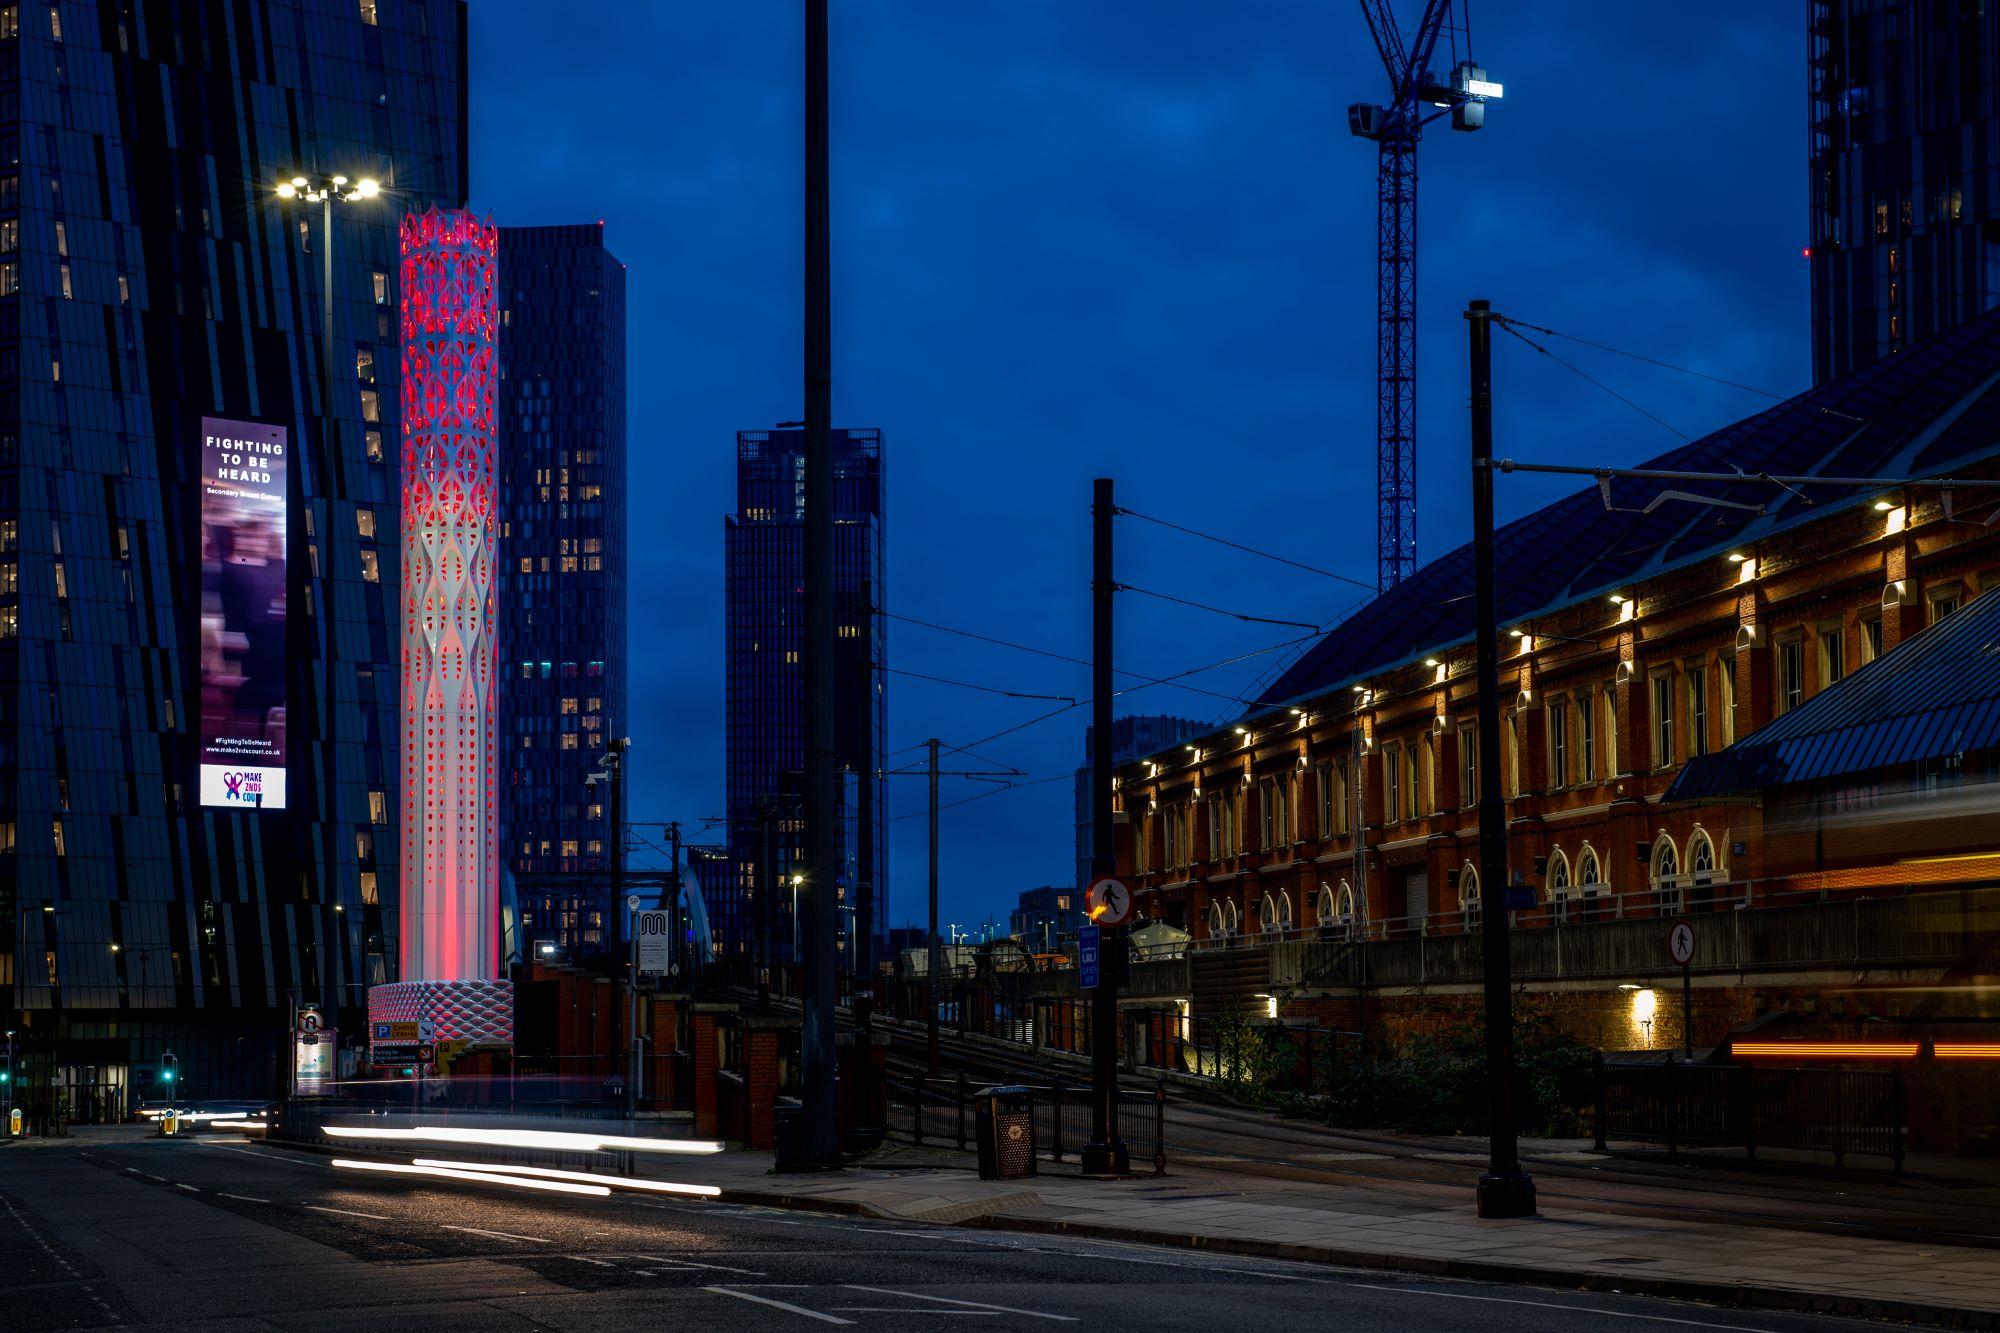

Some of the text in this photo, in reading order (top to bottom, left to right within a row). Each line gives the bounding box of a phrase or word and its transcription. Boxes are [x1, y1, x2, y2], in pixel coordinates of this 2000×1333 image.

[206, 436, 283, 455] FIGHTING
[221, 453, 268, 469] TO BE
[218, 468, 271, 484] HEARD
[206, 487, 239, 498] Secondary
[215, 738, 272, 746] #FightingToBeHeard
[206, 746, 280, 755] www.make2ndscount.co.uk
[244, 772, 262, 782] MAKE
[245, 782, 262, 792] 2NDS
[242, 793, 263, 802] COU
